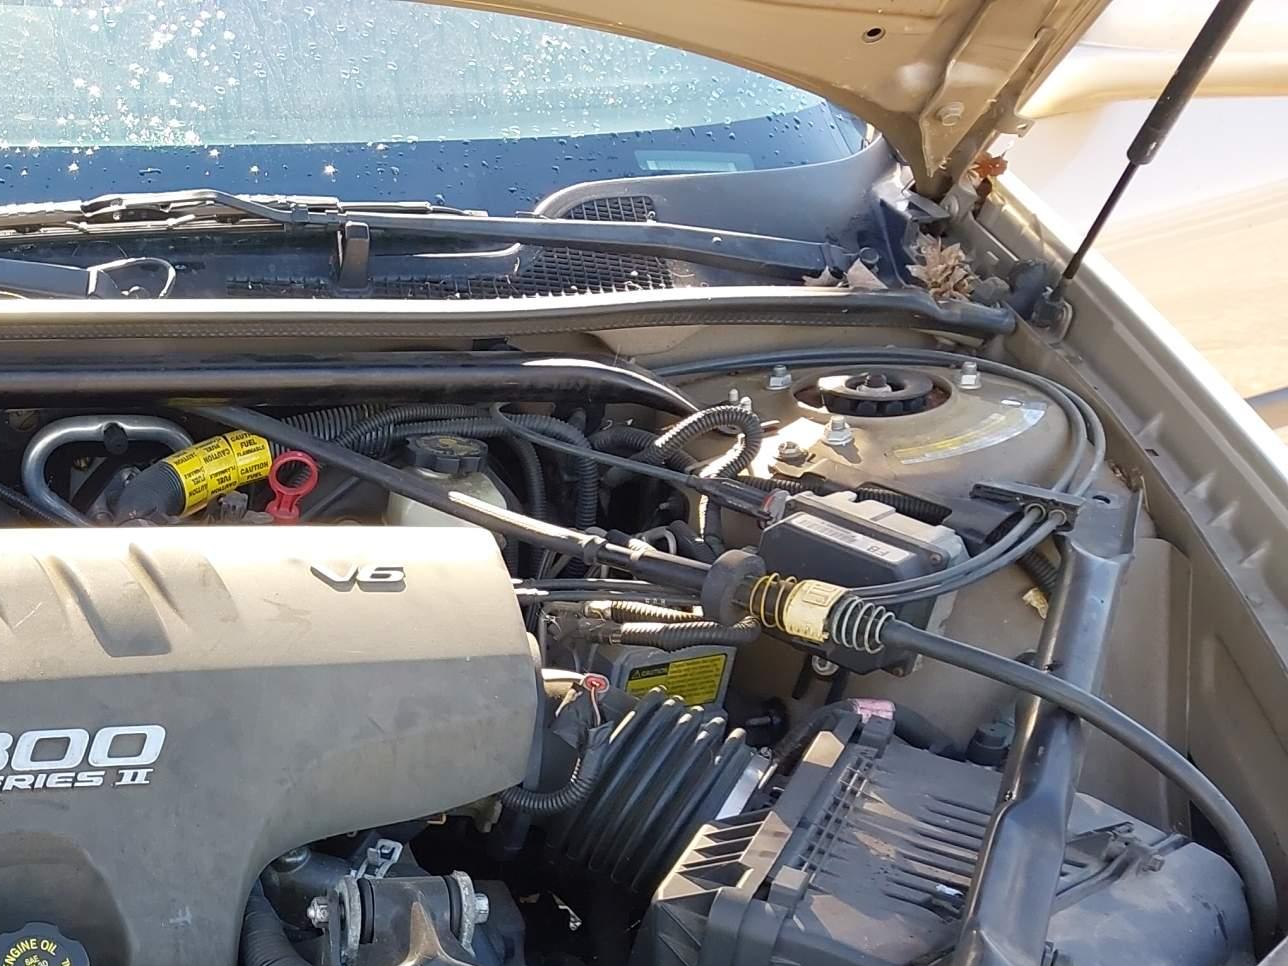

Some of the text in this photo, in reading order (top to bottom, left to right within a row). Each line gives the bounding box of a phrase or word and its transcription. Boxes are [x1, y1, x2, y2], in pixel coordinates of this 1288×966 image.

[240, 439, 257, 448] FUEL
[204, 448, 230, 464] CAUTION
[237, 445, 265, 456] FLAMMABLE
[240, 461, 268, 475] CAUTION
[216, 475, 231, 484] FUEL
[246, 472, 262, 480] FUEL
[310, 565, 406, 590] V6
[114, 767, 153, 786] II
[40, 939, 57, 956] OIL
[25, 955, 40, 966] SAE
